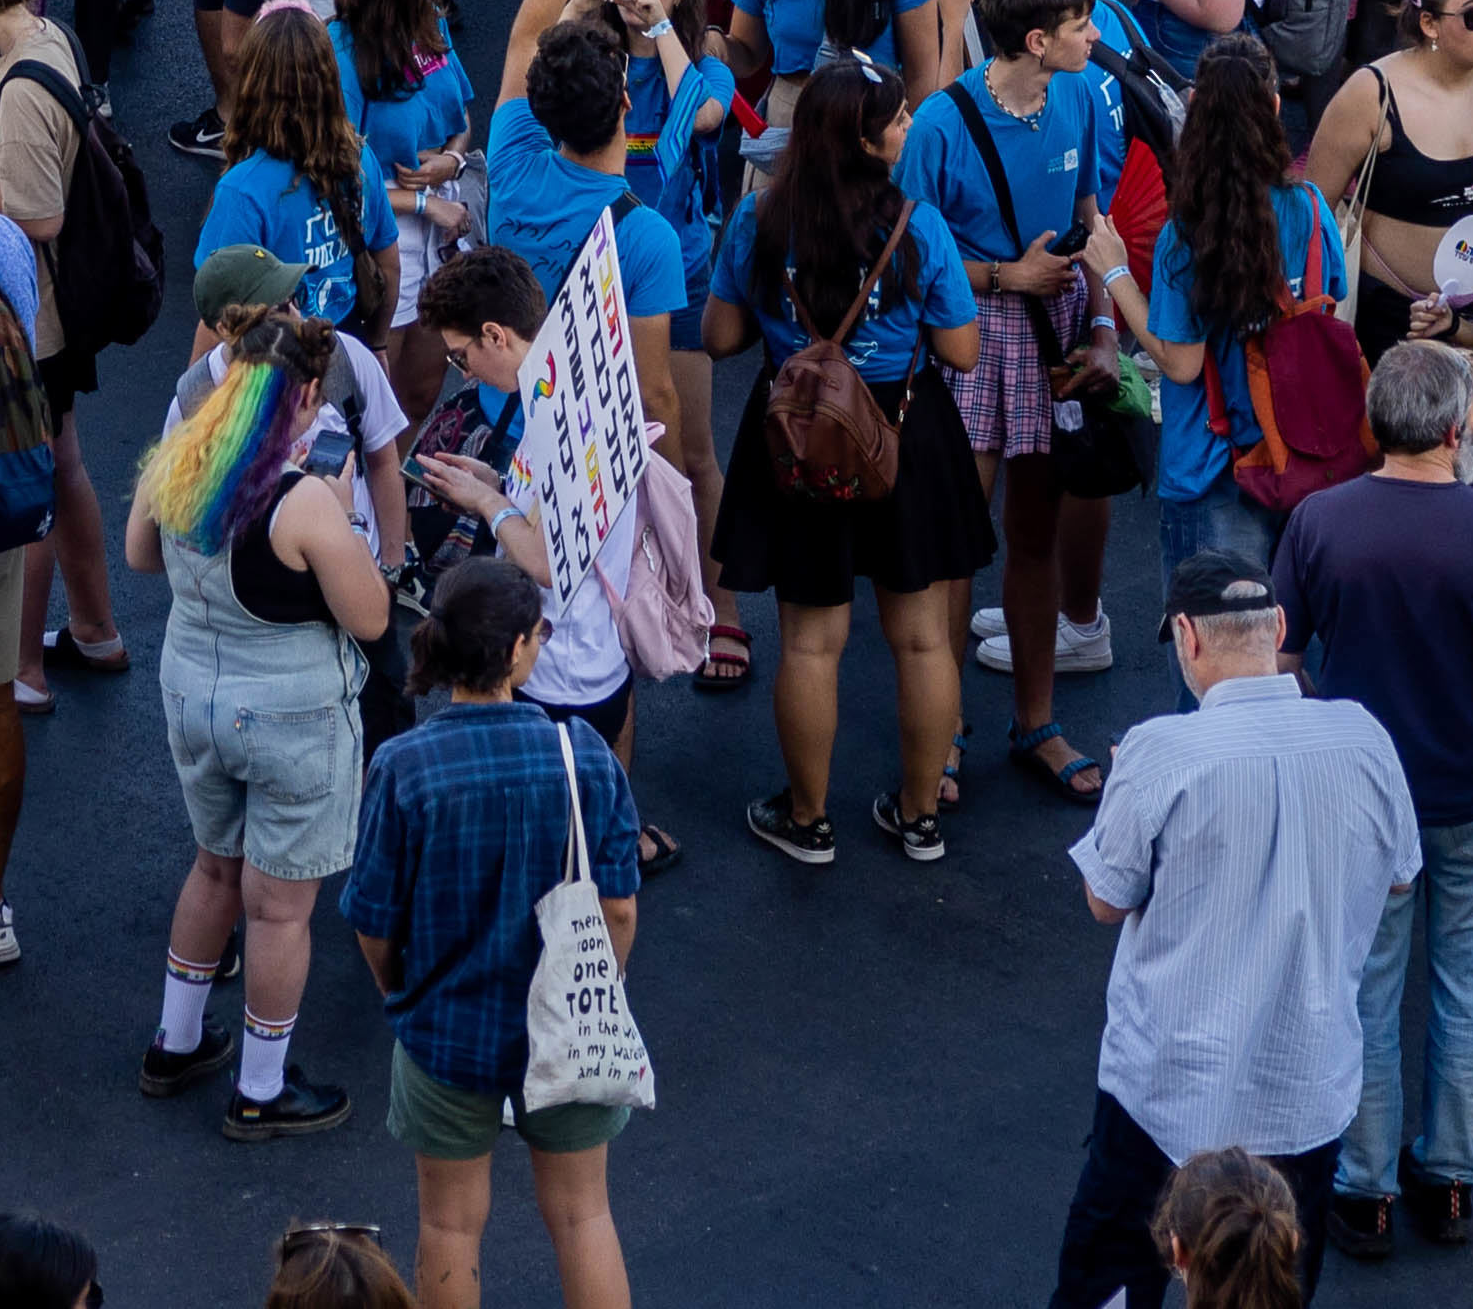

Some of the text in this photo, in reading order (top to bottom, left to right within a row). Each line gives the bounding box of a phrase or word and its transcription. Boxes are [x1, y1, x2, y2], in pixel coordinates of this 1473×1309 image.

[573, 958, 610, 983] one
[565, 983, 619, 1017] TOTE
[577, 1021, 592, 1037] in
[598, 1018, 619, 1037] the
[567, 1040, 581, 1059] in
[587, 1044, 607, 1060] my
[577, 1062, 601, 1081] and
[607, 1062, 622, 1079] in
